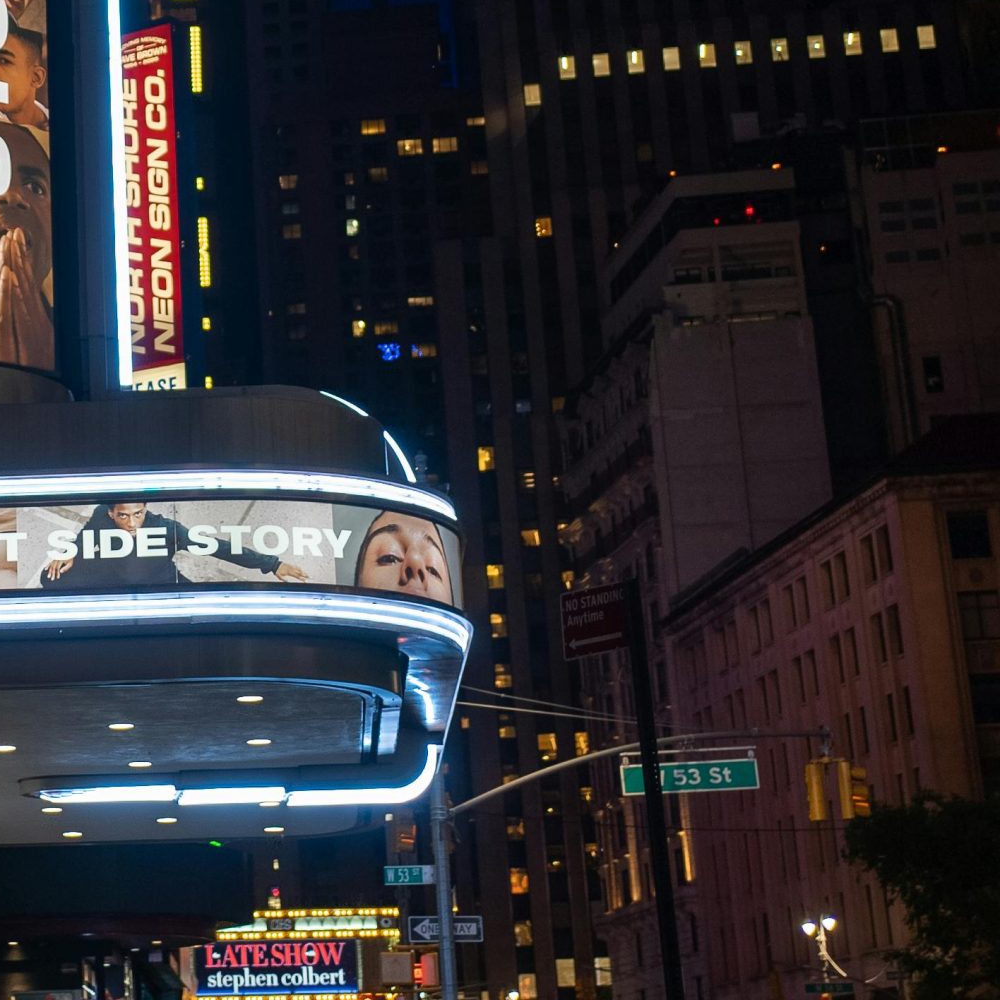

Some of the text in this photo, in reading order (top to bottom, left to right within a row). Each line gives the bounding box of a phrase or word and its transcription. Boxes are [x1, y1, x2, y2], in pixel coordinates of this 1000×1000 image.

[144, 69, 176, 354] NEON SIGN CO.
[47, 526, 169, 560] SIDE
[186, 524, 353, 559] STORY
[565, 600, 578, 612] NO
[567, 610, 605, 628] Anytime
[673, 768, 701, 785] 53
[709, 766, 732, 784] St
[398, 868, 409, 882] 53
[205, 942, 346, 968] LATE SHOW
[207, 966, 346, 994] stephen colbert
